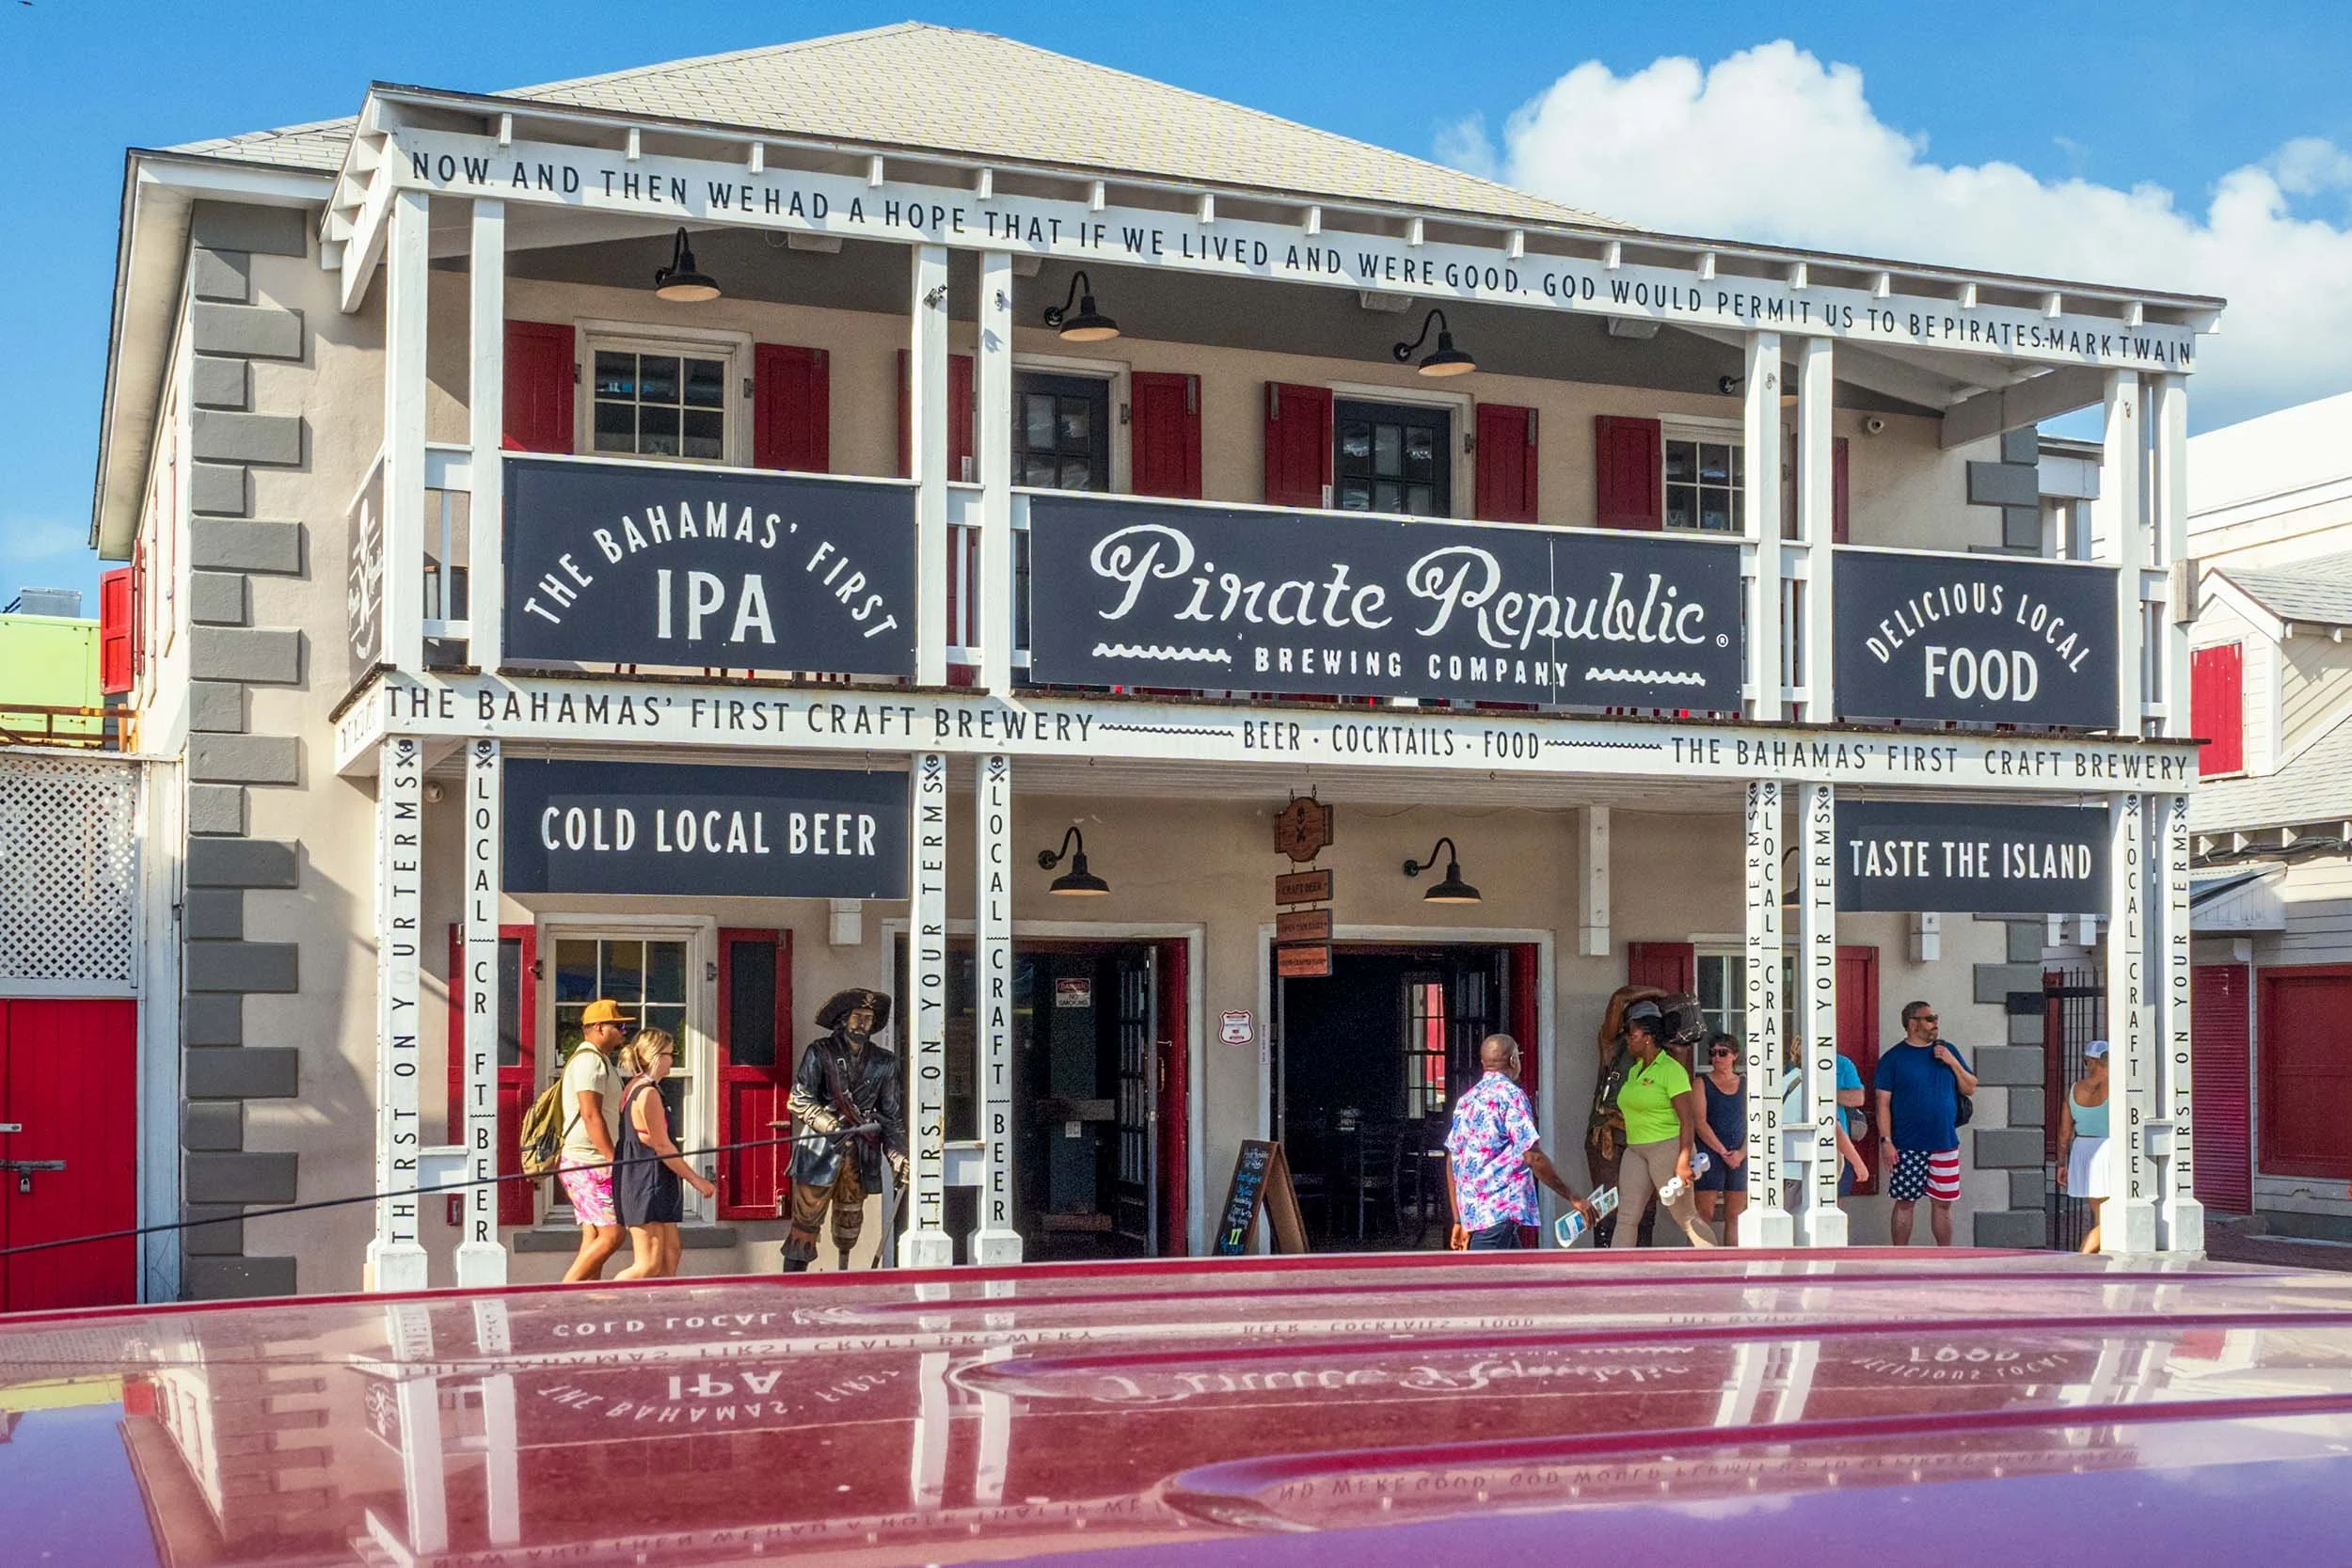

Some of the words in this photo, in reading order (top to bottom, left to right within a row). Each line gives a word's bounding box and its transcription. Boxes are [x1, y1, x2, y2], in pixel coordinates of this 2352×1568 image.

[412, 152, 489, 186] NOW
[513, 161, 580, 193] AND
[600, 170, 687, 205] THEN
[849, 196, 865, 224] A
[885, 200, 964, 232] HOPE
[984, 211, 1061, 245] THAT
[1081, 222, 1105, 249] IF
[1122, 226, 1164, 256] WE
[1183, 232, 1268, 267] LIVED
[1285, 245, 1341, 274] AND
[1359, 252, 1434, 286] WERE
[1446, 262, 1528, 295] GOOD,
[1543, 273, 1595, 301] GOD
[1611, 279, 1702, 312] WOULD
[1718, 292, 1810, 325] PERMIT
[1825, 304, 1853, 328] US
[1867, 308, 1895, 333] TO
[2120, 335, 2190, 365] TWAIN
[523, 553, 595, 625] THE
[593, 500, 799, 564] BAHAMAS'
[806, 541, 898, 640] FIRST
[658, 568, 778, 644] IPA
[1090, 523, 1392, 622] Pirate
[1406, 545, 1706, 651] Republic
[1255, 646, 1402, 677] BREWING
[1428, 653, 1569, 688] COMPANY
[1866, 582, 2004, 663] DELICIOUS
[2016, 594, 2090, 673] LOCAL
[1925, 645, 2039, 703] FOOD
[385, 686, 454, 719] THE
[478, 689, 673, 726] BAHAMAS'
[691, 698, 790, 732] FIRST
[807, 703, 913, 736] CRAFT
[934, 707, 1094, 742] BREWERY
[1243, 721, 1301, 752] BEER
[1332, 723, 1454, 756] COCKTAILS
[1484, 730, 1539, 760] FOOD
[1671, 736, 1721, 764] THE
[1736, 738, 1875, 771] BAHAMAS'
[1887, 744, 1958, 773] FIRST
[1985, 749, 2061, 778] CRAFT
[2075, 751, 2187, 781] BREWERY
[393, 776, 417, 897] TERMS
[474, 776, 490, 922] LOCAL
[542, 806, 635, 851] COLD
[657, 808, 770, 854] LOCAL
[789, 812, 877, 856] BEER
[922, 782, 943, 895] TERMS
[990, 785, 1004, 922] LOCAL
[1748, 810, 1760, 911] TERMS
[1764, 812, 1774, 933] LOCAL
[1815, 813, 1831, 909] TERMS
[1850, 840, 1930, 878] TASTE
[1942, 841, 1990, 879] THE
[2003, 842, 2091, 880] ISLAND
[2172, 823, 2186, 911] TERMS
[2127, 824, 2137, 939] LOCAL
[922, 924, 942, 1011] YOUR
[1749, 935, 1760, 1012] YOUR
[1816, 933, 1832, 1010] YOUR
[2173, 934, 2187, 1007] YOUR
[392, 1035, 416, 1078] ON
[921, 1040, 941, 1080] ON
[992, 948, 1005, 1085] CRAFT
[1749, 1033, 1760, 1067] ON
[1765, 965, 1775, 1086] CRAFT
[1817, 1036, 1833, 1070] ON
[2128, 962, 2138, 1076] CRAFT
[2174, 1031, 2188, 1064] ON
[475, 1128, 489, 1243] BEER
[920, 1101, 941, 1228] THIRST
[993, 1113, 1006, 1221] BEER
[1749, 1092, 1761, 1203] THIRST
[1767, 1110, 1776, 1207] BEER
[1818, 1096, 1836, 1208] THIRST
[2130, 1107, 2139, 1198] BEER
[2175, 1087, 2191, 1193] THIRST
